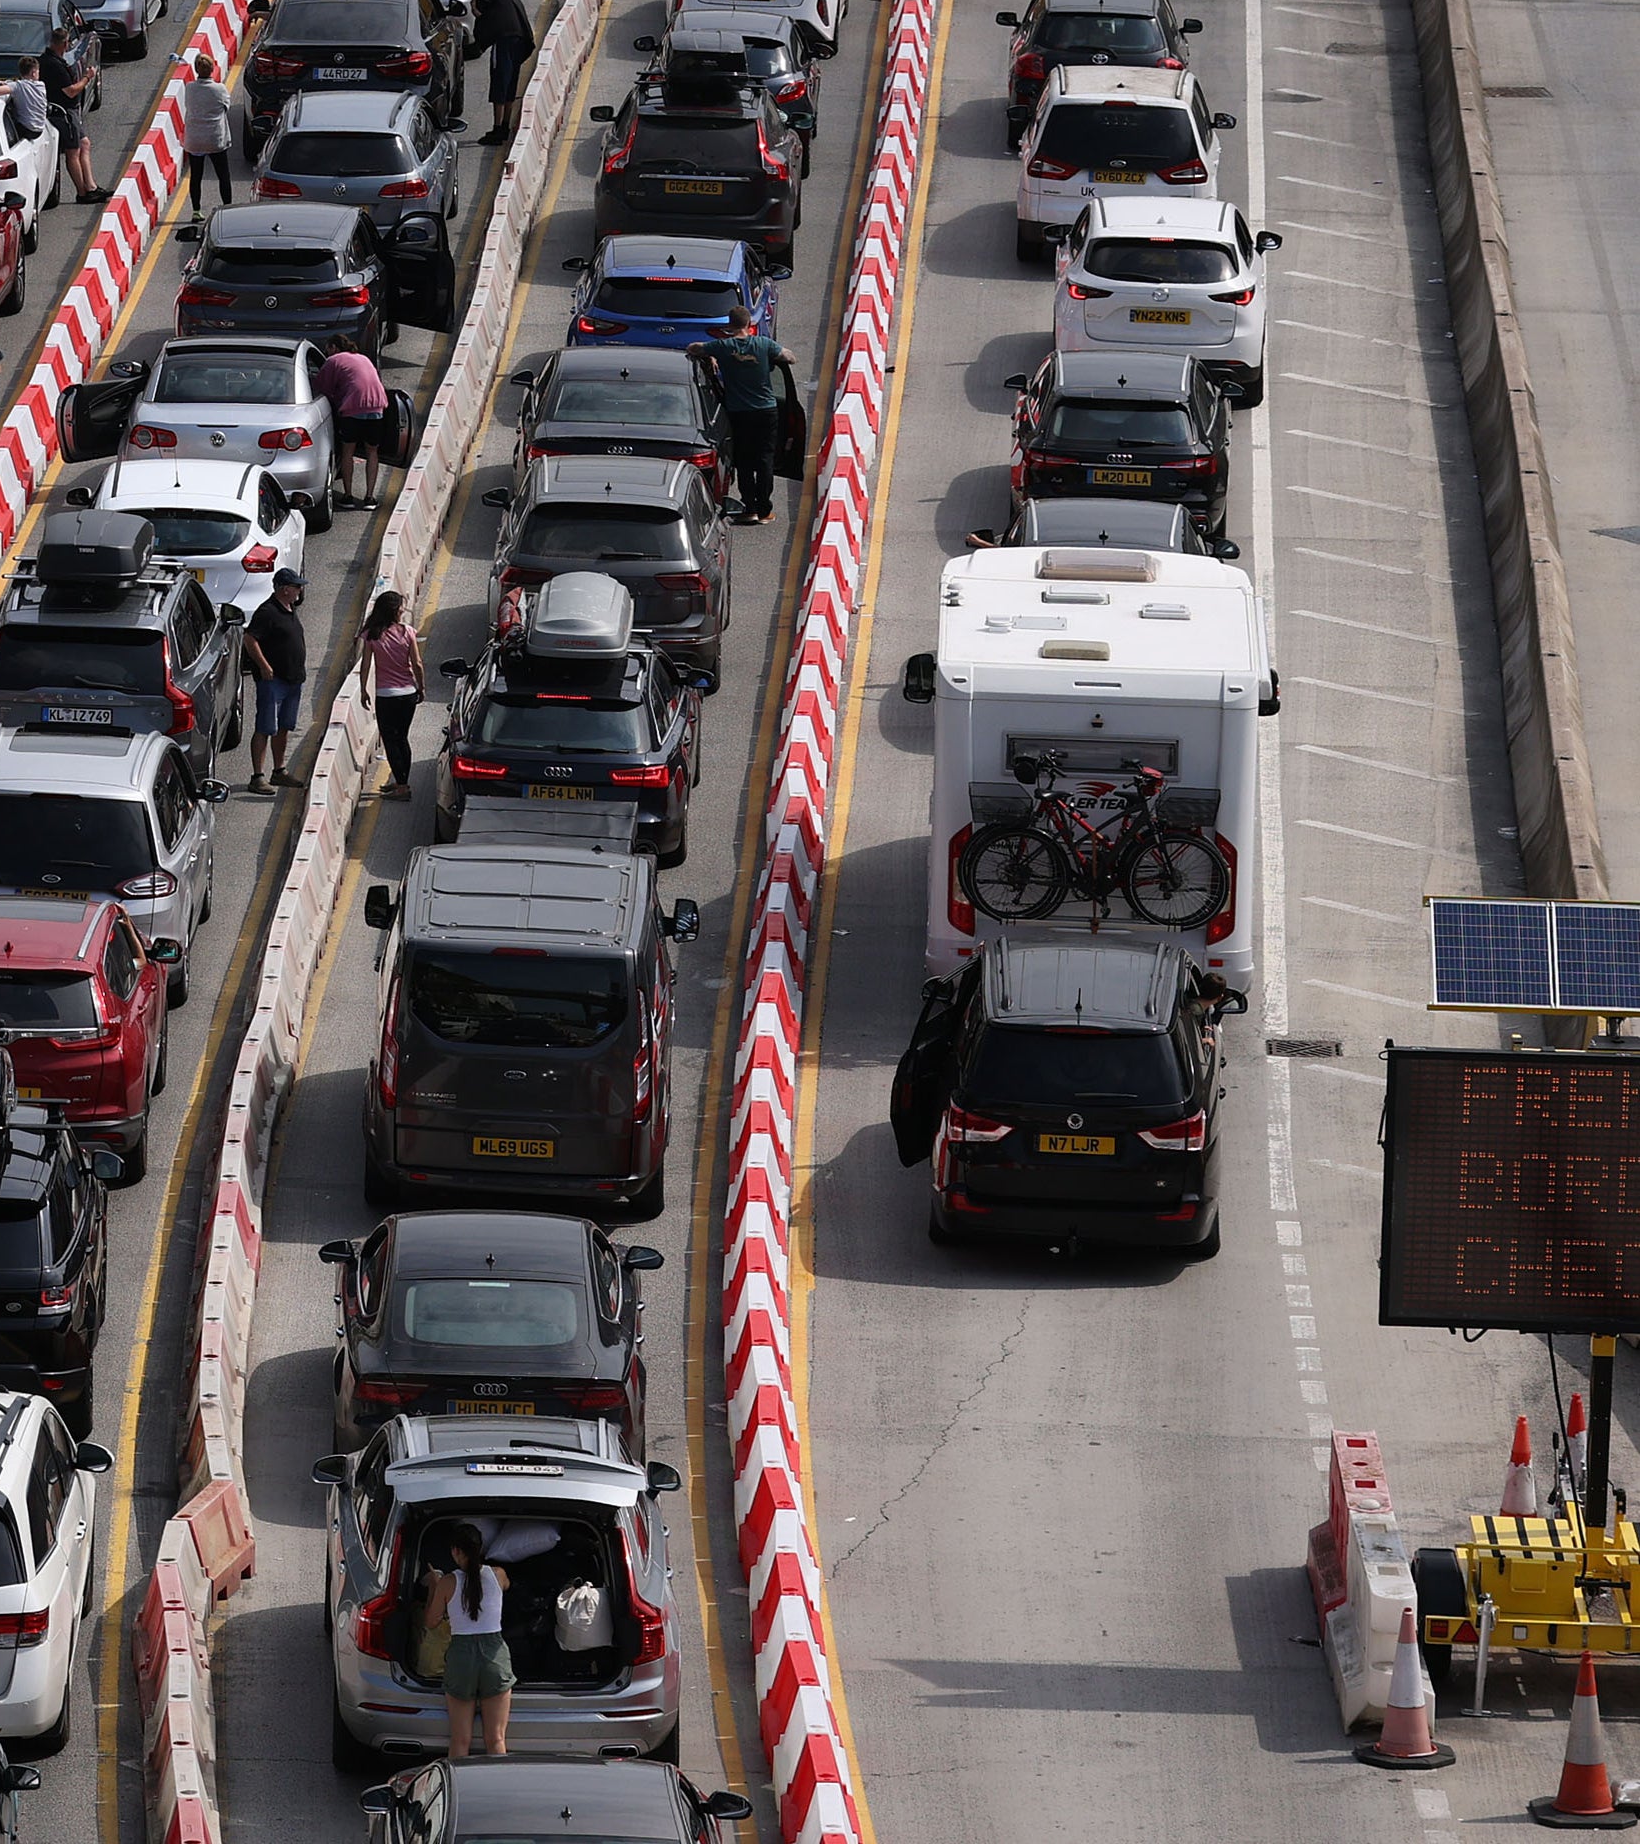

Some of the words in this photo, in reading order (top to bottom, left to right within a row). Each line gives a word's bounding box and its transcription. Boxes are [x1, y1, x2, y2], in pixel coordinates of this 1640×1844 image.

[1093, 170, 1121, 184] GY60
[1123, 170, 1146, 184] ZCX
[1079, 186, 1096, 198] UK
[1133, 310, 1163, 324] YN22
[1165, 310, 1187, 324] KNS
[1092, 470, 1123, 484] LM20
[1126, 470, 1150, 484] LLA
[87, 710, 111, 724] 749
[530, 786, 565, 801] AF64
[567, 786, 595, 802] LNM
[479, 1140, 517, 1156] ML69
[520, 1140, 549, 1156] UGS
[1047, 1135, 1068, 1152] N7
[1070, 1135, 1100, 1153] LJR
